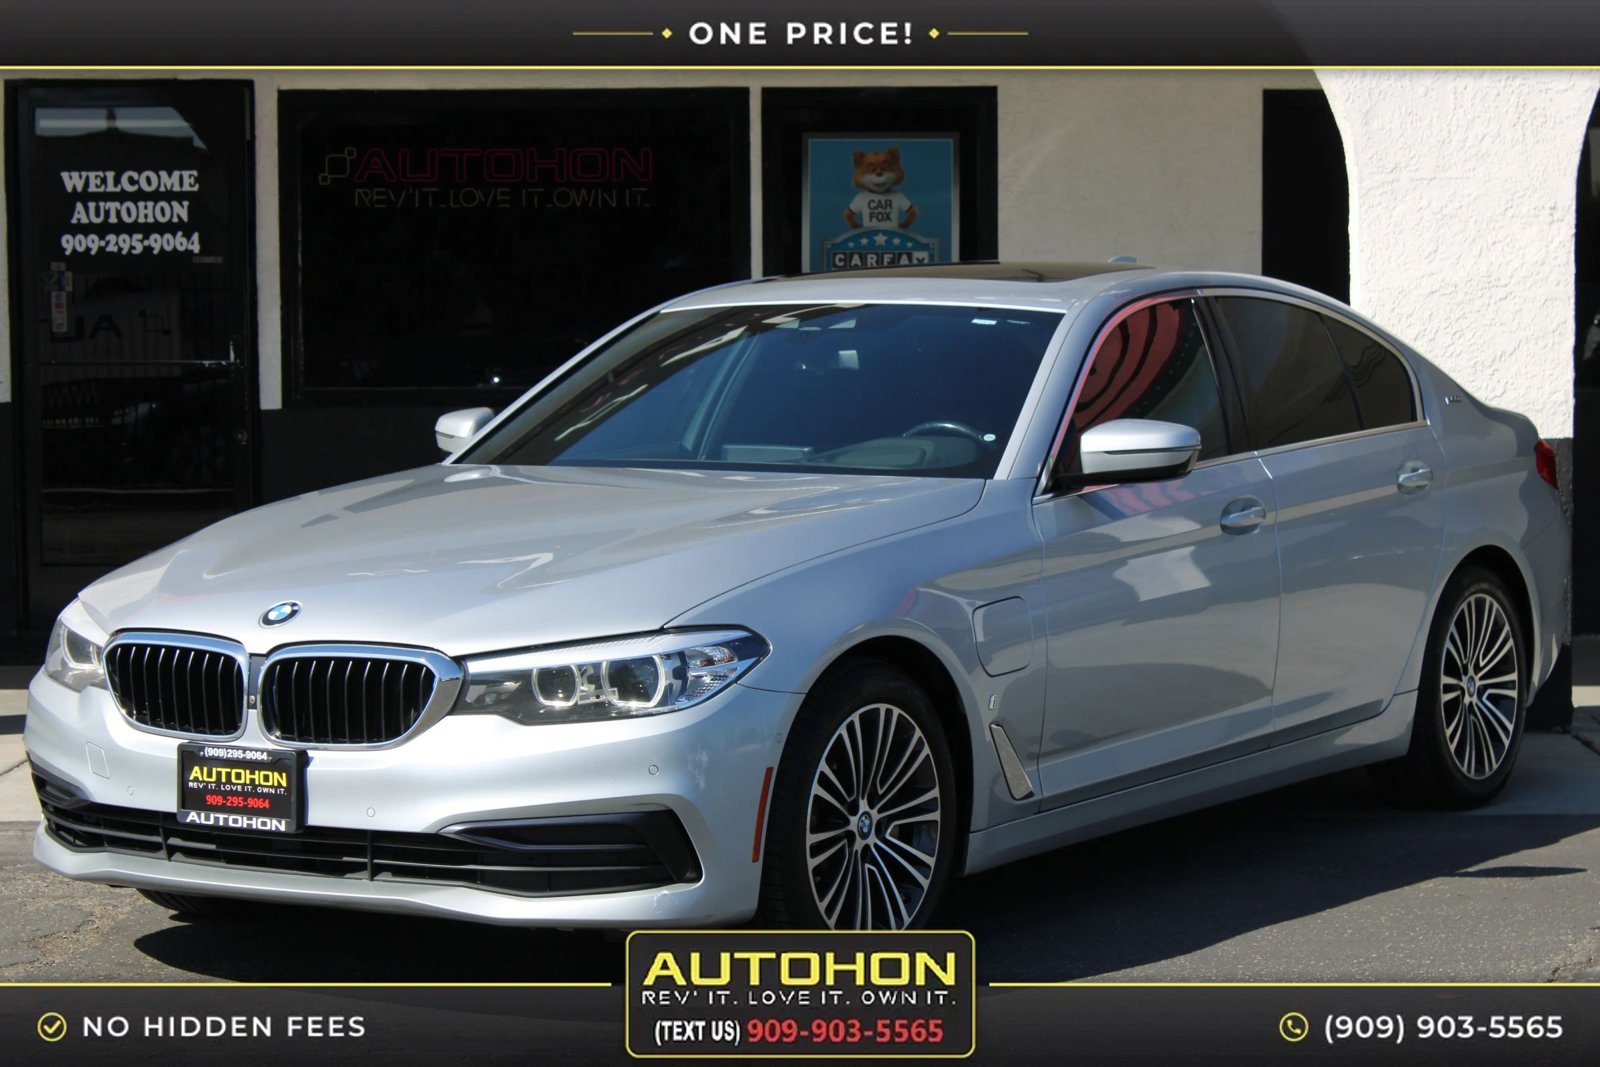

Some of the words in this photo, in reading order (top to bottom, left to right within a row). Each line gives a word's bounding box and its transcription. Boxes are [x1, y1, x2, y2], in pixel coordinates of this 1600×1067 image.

[354, 147, 653, 183] AUTOHON
[60, 170, 199, 193] WELCOME
[449, 187, 511, 208] LOVE
[867, 200, 893, 211] CAR
[71, 200, 190, 224] AUTOHON
[869, 212, 892, 223] FOX
[60, 231, 201, 255] 909-295-9064
[204, 747, 268, 761] (909)295-9064
[190, 766, 287, 787] AUTOHON
[220, 784, 243, 792] LOVE
[205, 794, 270, 809] 909-295-9064
[186, 812, 286, 831] AUTOHON
